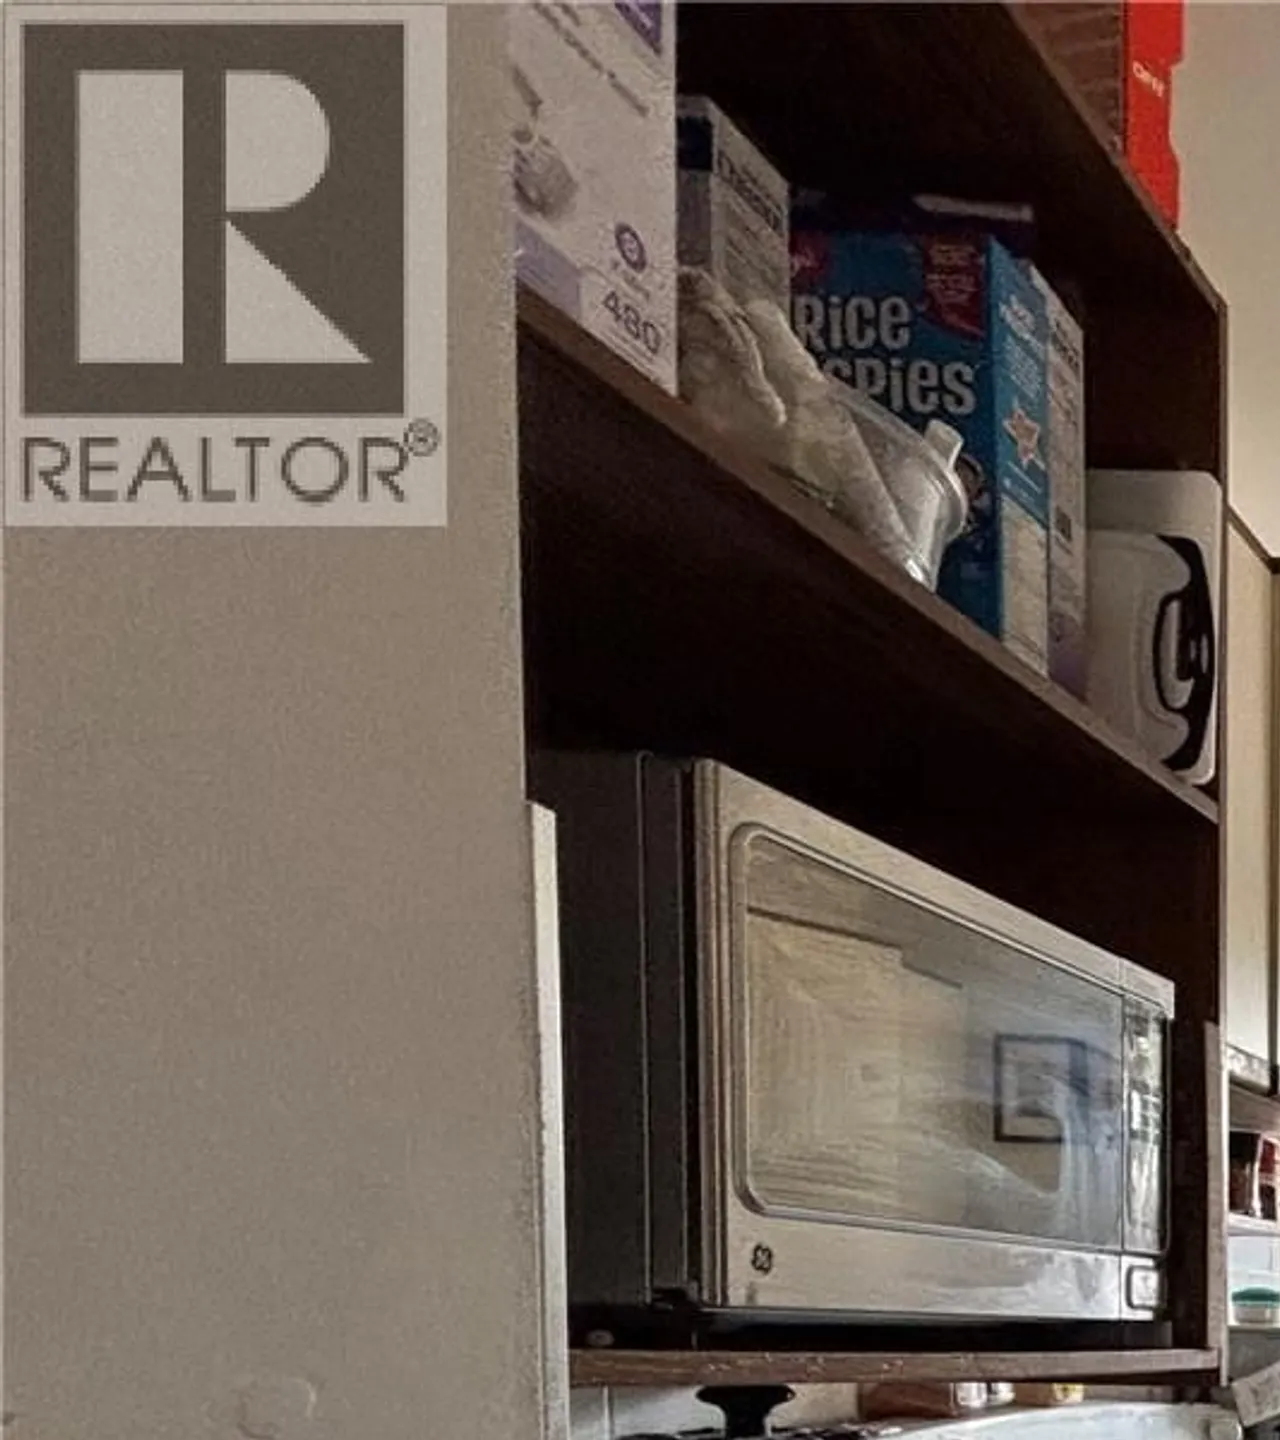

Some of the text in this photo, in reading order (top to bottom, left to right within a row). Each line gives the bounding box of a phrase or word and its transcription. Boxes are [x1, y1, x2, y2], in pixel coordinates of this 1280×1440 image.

[603, 290, 661, 355] 480
[793, 295, 912, 352] Rice
[823, 357, 978, 415] pies
